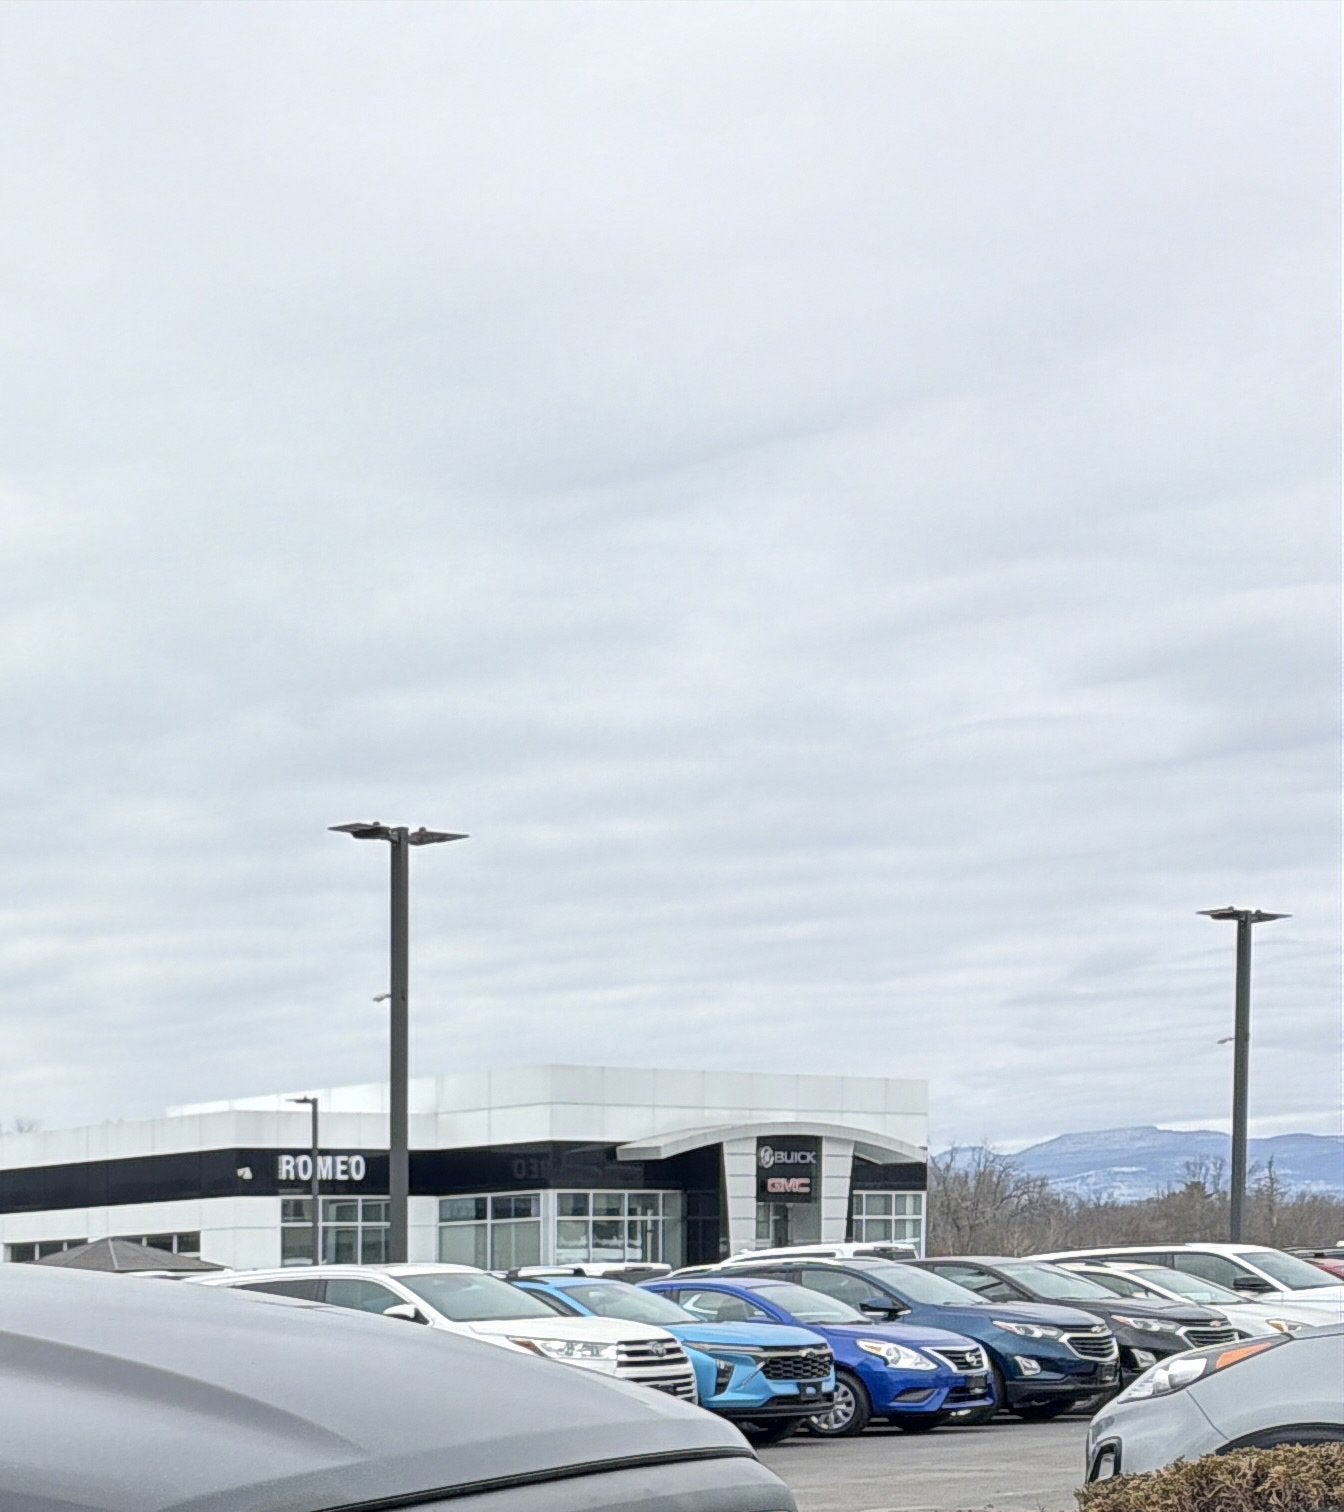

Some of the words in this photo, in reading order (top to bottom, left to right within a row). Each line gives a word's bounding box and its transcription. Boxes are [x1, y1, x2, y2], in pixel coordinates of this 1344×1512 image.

[774, 1150, 817, 1164] BUICK
[277, 1154, 366, 1181] ROMEO
[767, 1177, 811, 1193] GMC
